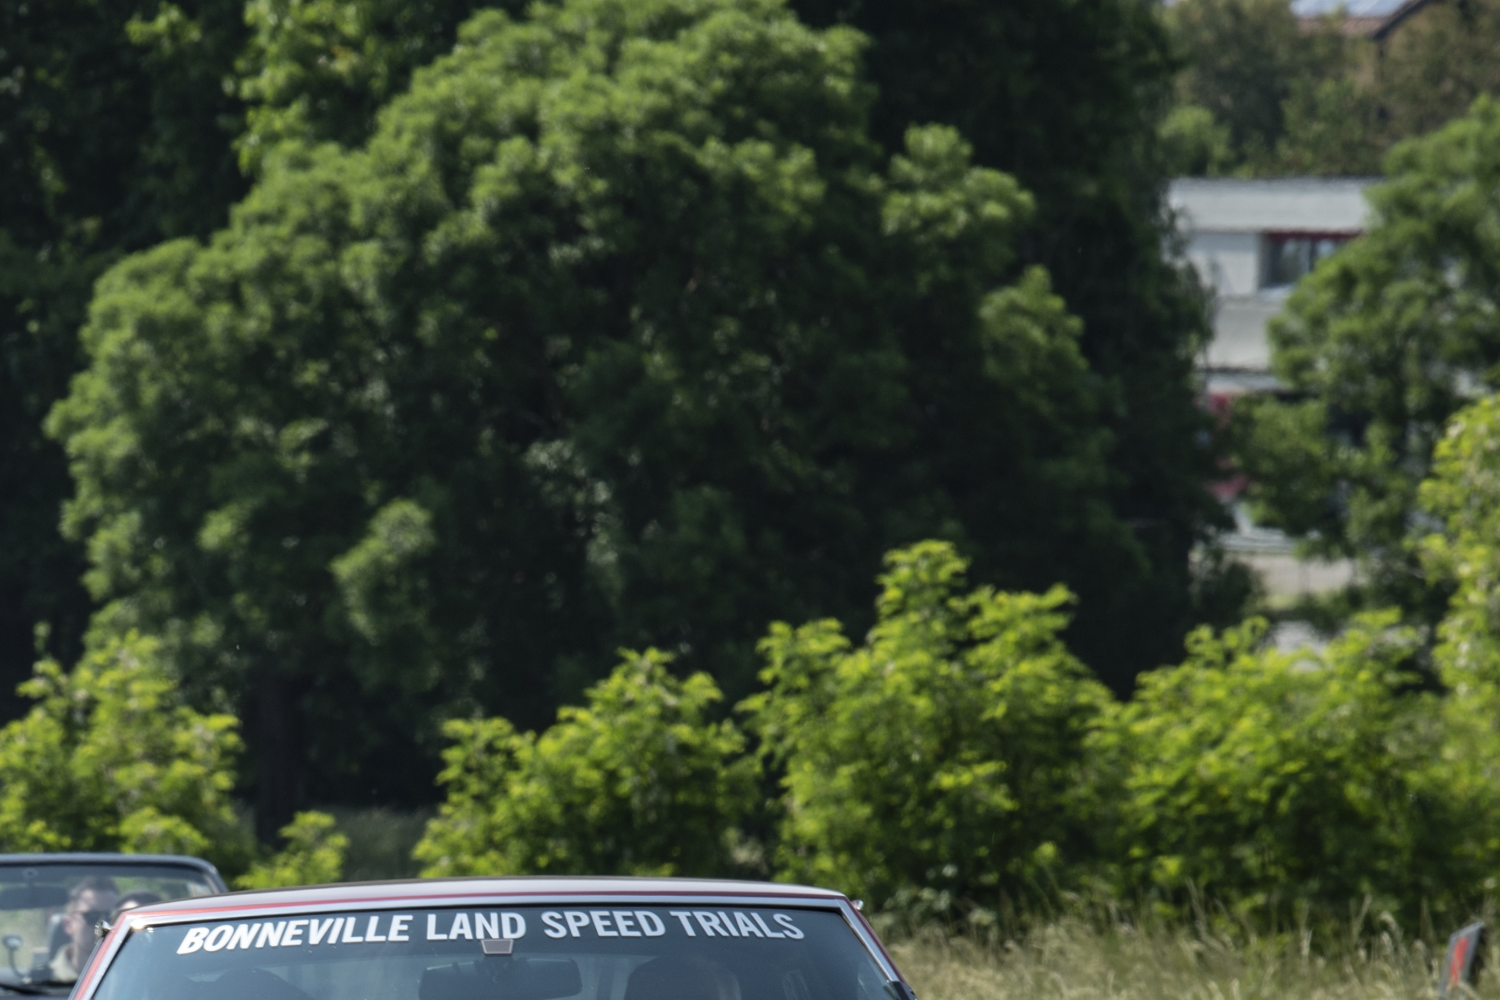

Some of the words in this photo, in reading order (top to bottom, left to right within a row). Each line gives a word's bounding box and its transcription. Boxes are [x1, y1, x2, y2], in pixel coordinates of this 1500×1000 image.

[176, 914, 414, 955] BONNEVILLE
[426, 912, 526, 940] LAND
[540, 910, 666, 938] SPEED
[670, 910, 805, 940] TRIALS
